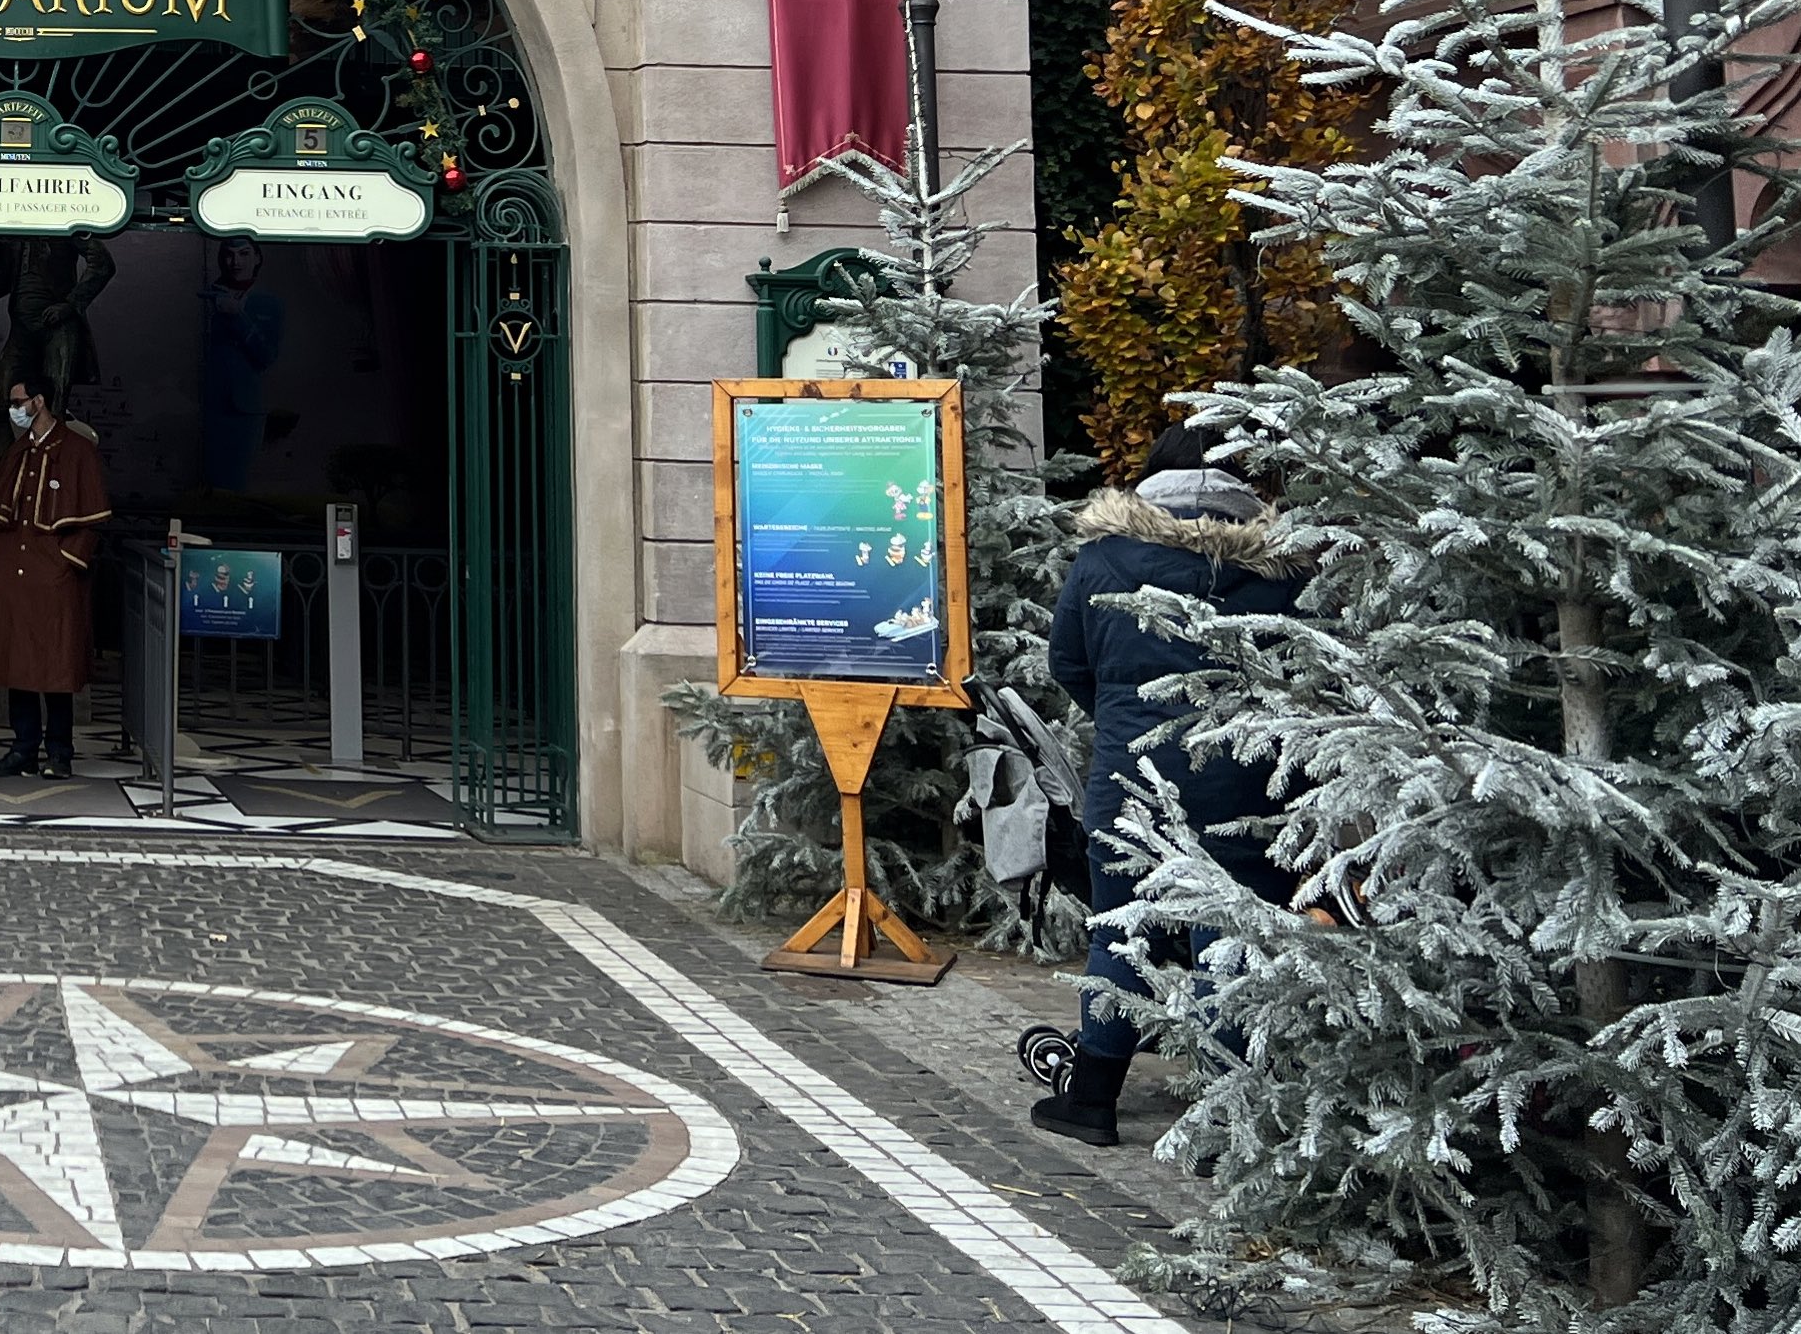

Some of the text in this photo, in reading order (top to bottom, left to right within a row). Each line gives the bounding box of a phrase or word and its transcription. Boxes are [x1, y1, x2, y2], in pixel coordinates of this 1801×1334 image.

[282, 108, 341, 127] WARTEZEIT
[303, 129, 318, 150] 5
[262, 183, 363, 200] EINGANG
[14, 202, 68, 213] PASSAGER
[70, 203, 100, 214] SOLO
[255, 208, 368, 219] ENTRANCE ENTRÉE
